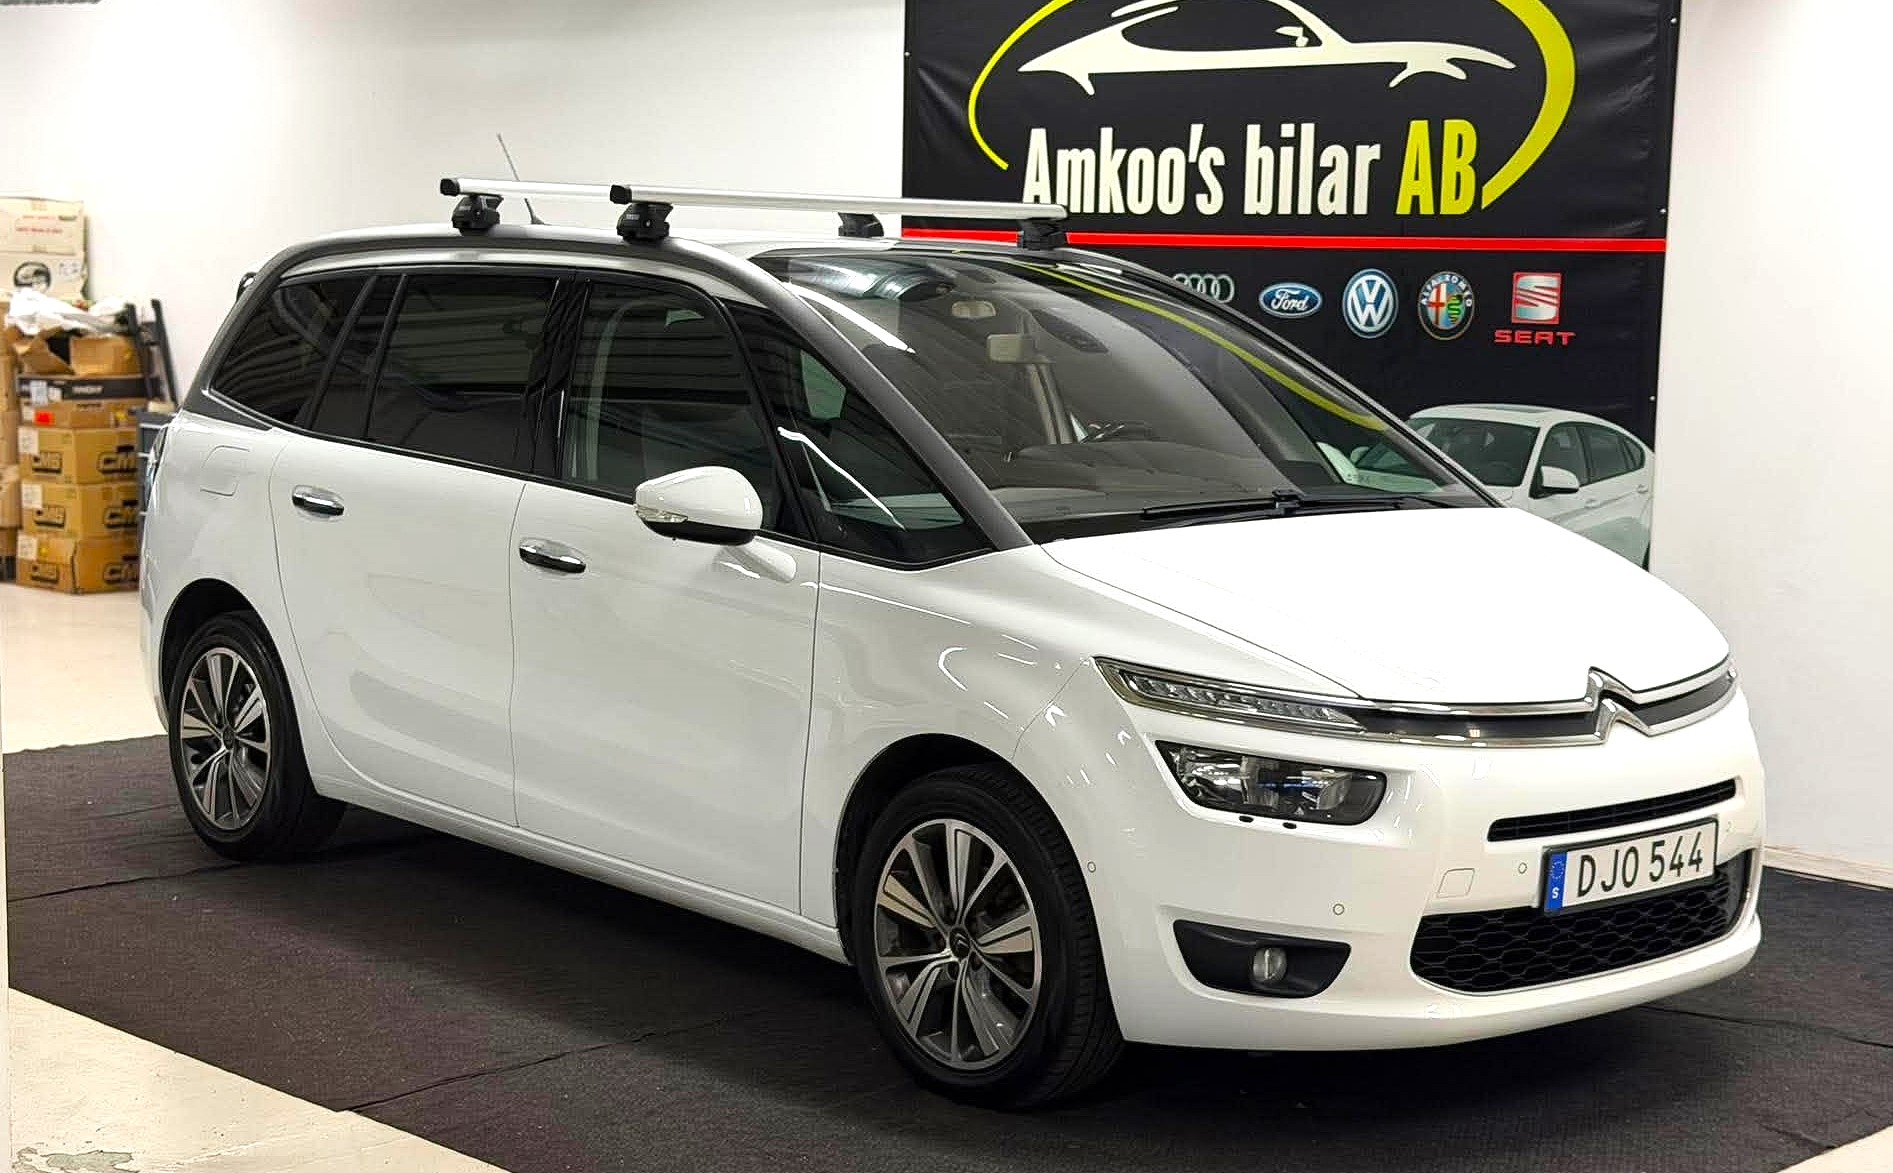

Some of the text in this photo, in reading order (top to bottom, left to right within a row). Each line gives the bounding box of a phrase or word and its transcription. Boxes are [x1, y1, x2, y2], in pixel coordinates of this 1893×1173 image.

[1022, 119, 1478, 215] Amkoo's bilar AB
[1270, 287, 1310, 312] Ford
[1494, 329, 1577, 346] SEAT
[1577, 831, 1703, 898] DJO 544
[1552, 886, 1560, 900] S
